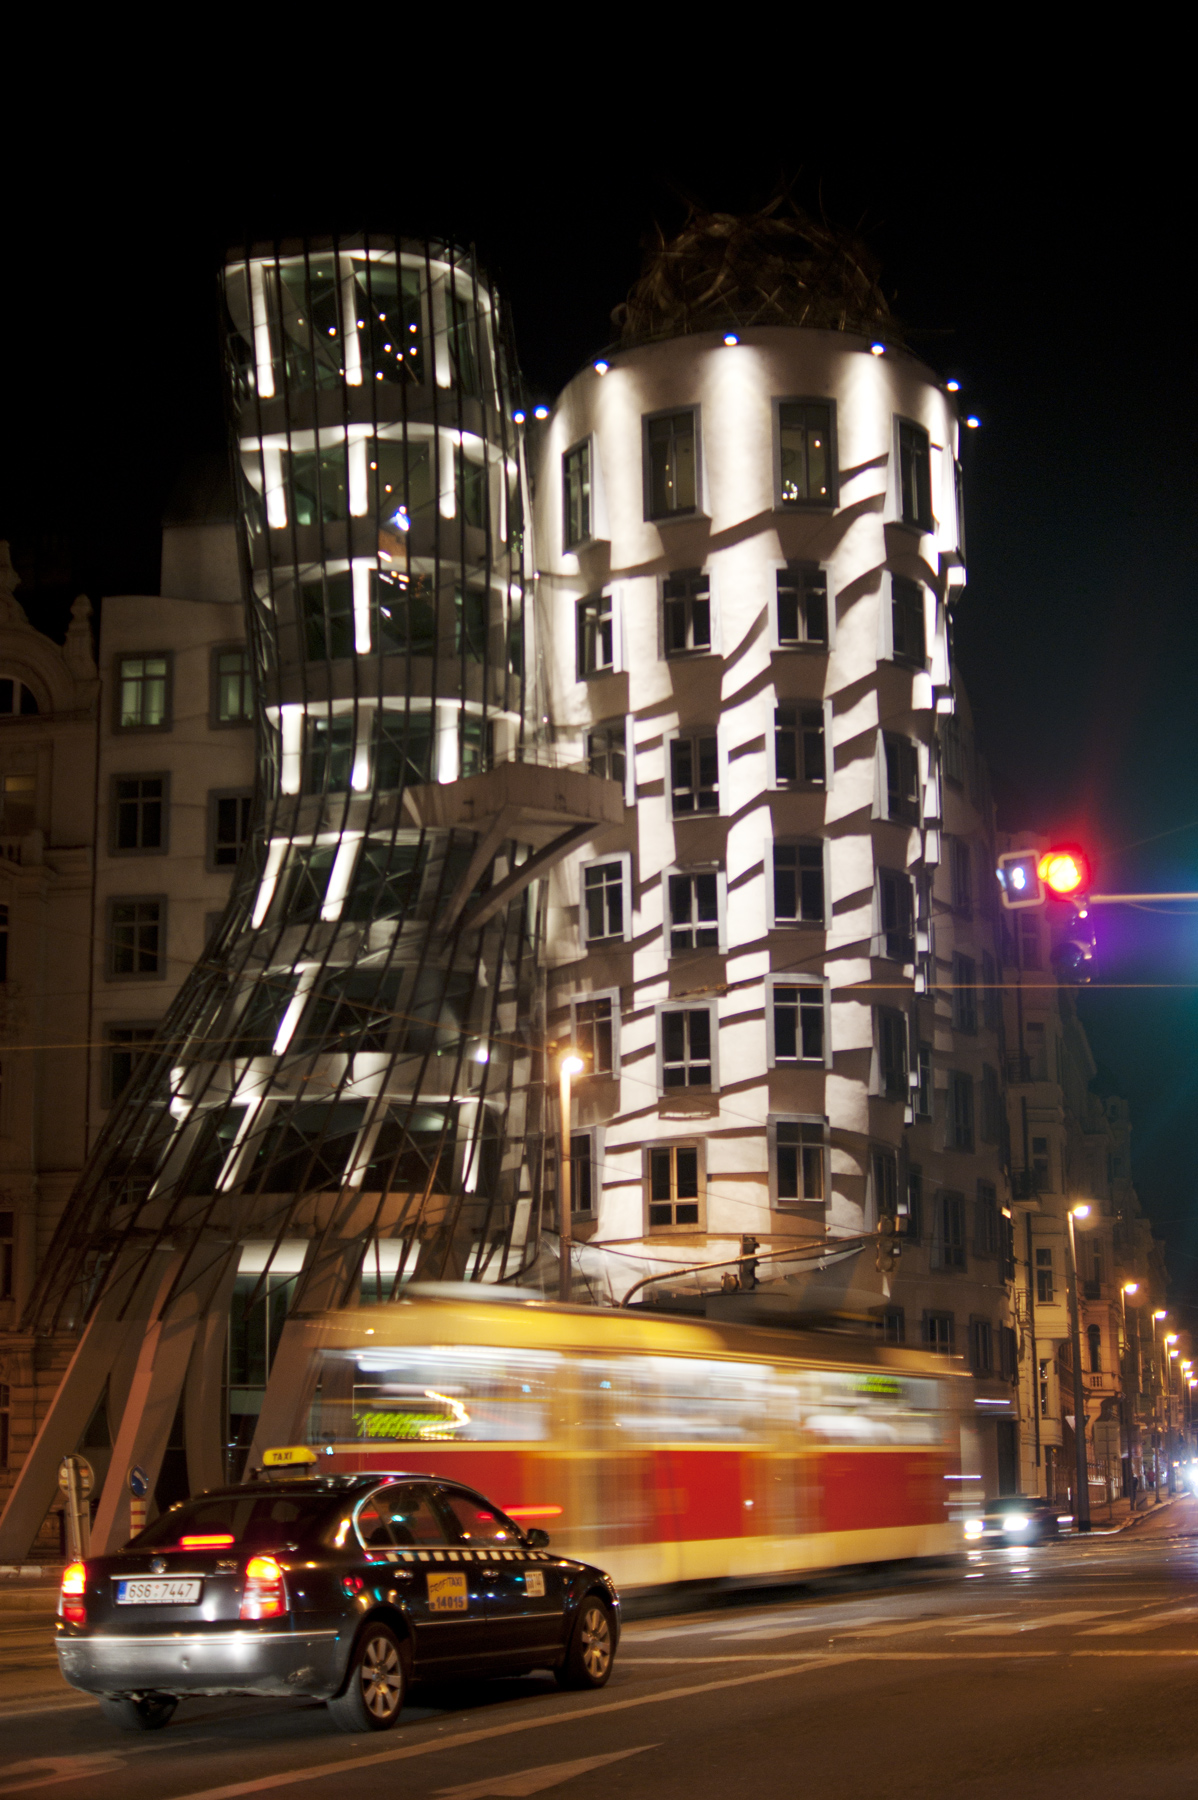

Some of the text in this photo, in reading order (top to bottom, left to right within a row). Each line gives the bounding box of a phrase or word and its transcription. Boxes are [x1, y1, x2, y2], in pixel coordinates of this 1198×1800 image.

[272, 1452, 293, 1461] TAXI
[128, 1583, 194, 1599] 6S6 7447
[436, 1596, 464, 1609] 14015
